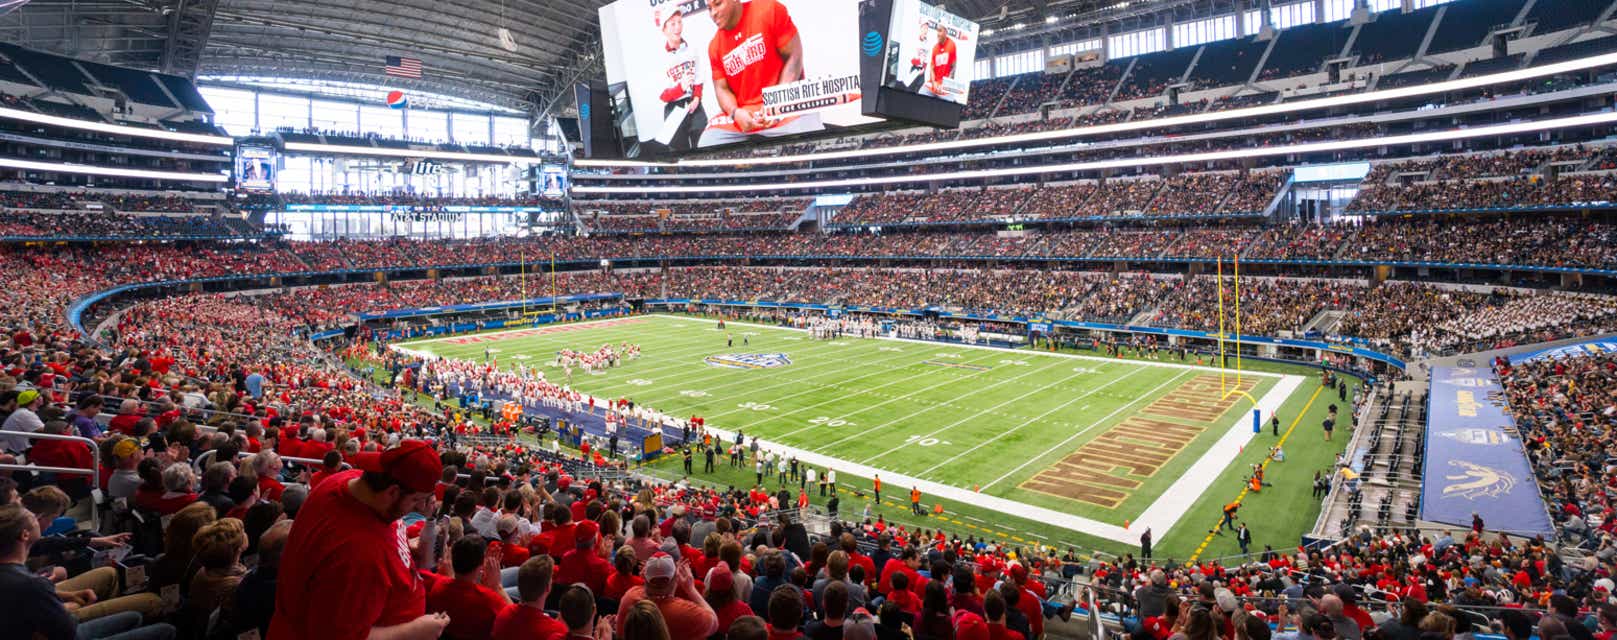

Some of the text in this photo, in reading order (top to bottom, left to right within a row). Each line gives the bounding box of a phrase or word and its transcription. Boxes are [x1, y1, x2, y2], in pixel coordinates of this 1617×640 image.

[762, 86, 800, 106] SCOTTISH
[802, 81, 820, 99] RITE
[392, 212, 464, 223] AT&T STADIUM
[808, 416, 847, 427] 20
[905, 435, 939, 446] 10
[1016, 416, 1208, 509] MICHIGAN
